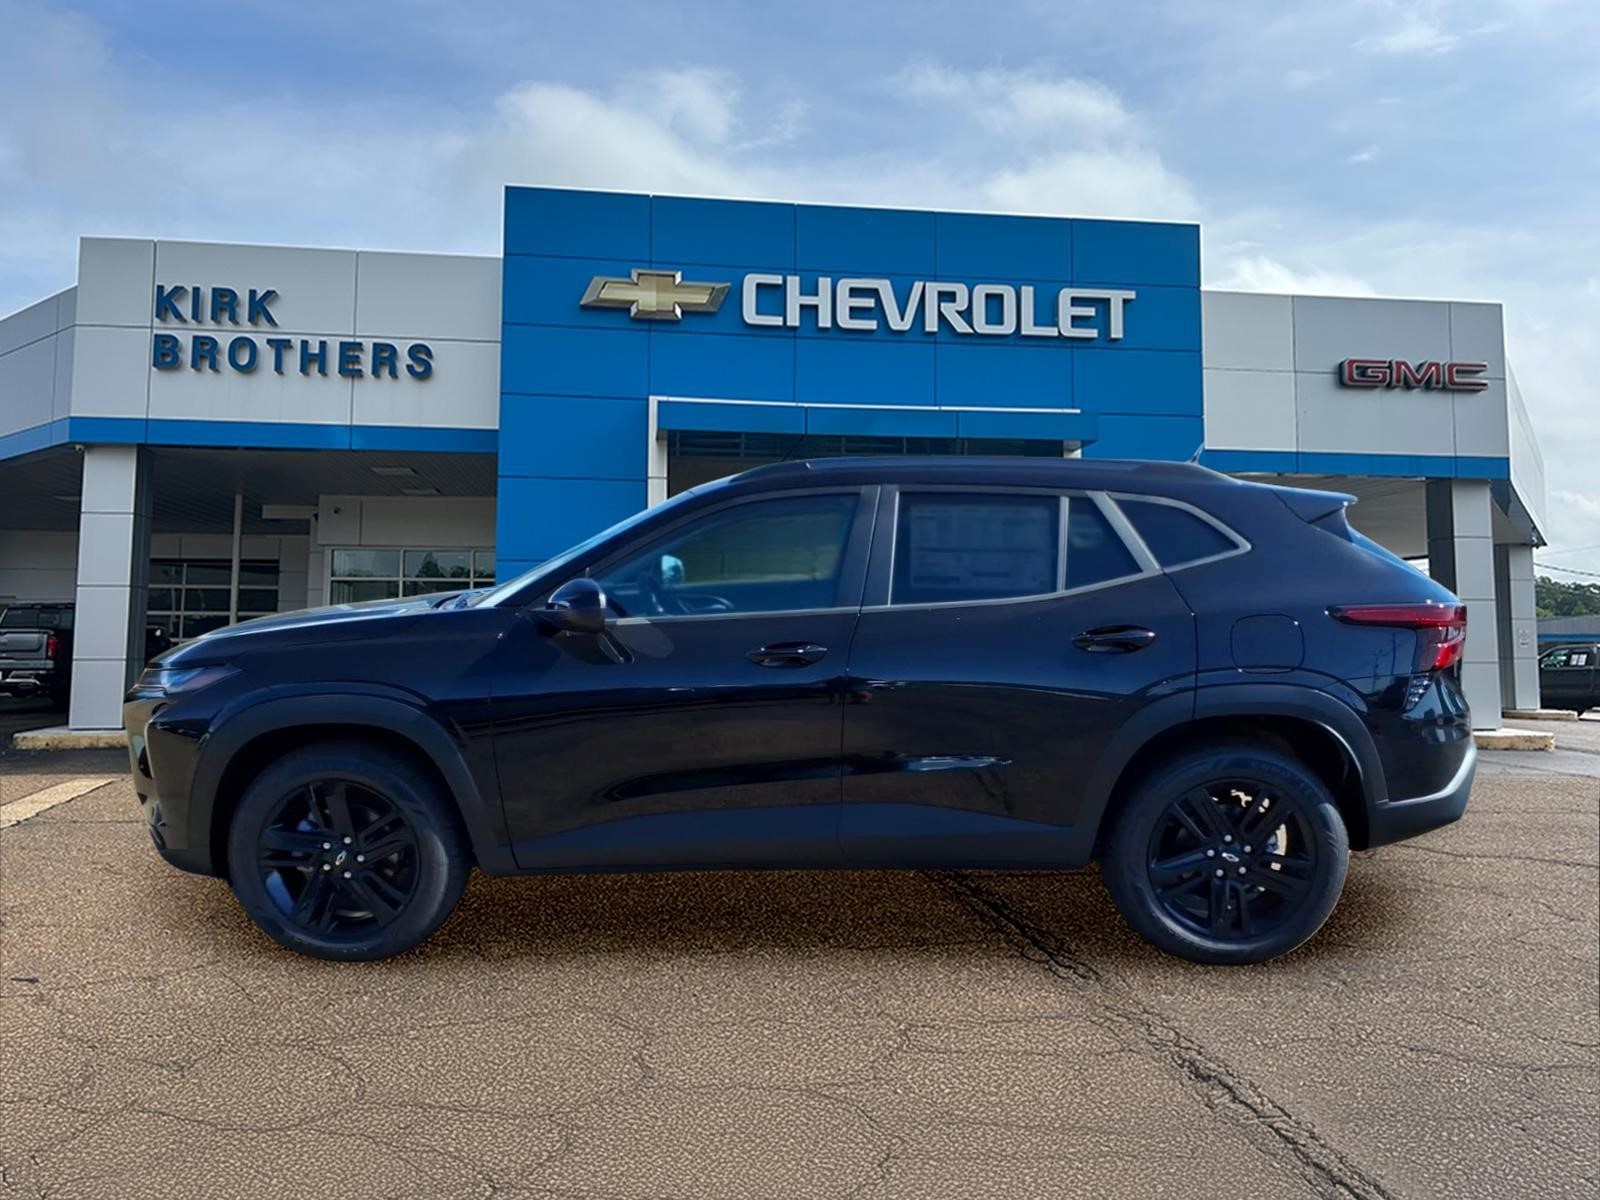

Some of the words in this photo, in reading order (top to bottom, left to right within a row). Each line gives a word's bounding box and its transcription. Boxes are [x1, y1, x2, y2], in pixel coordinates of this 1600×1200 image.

[154, 284, 279, 327] KIRK
[742, 273, 1136, 339] CHEVROLET
[152, 333, 434, 379] BROTHERS
[1341, 357, 1488, 391] GMC
